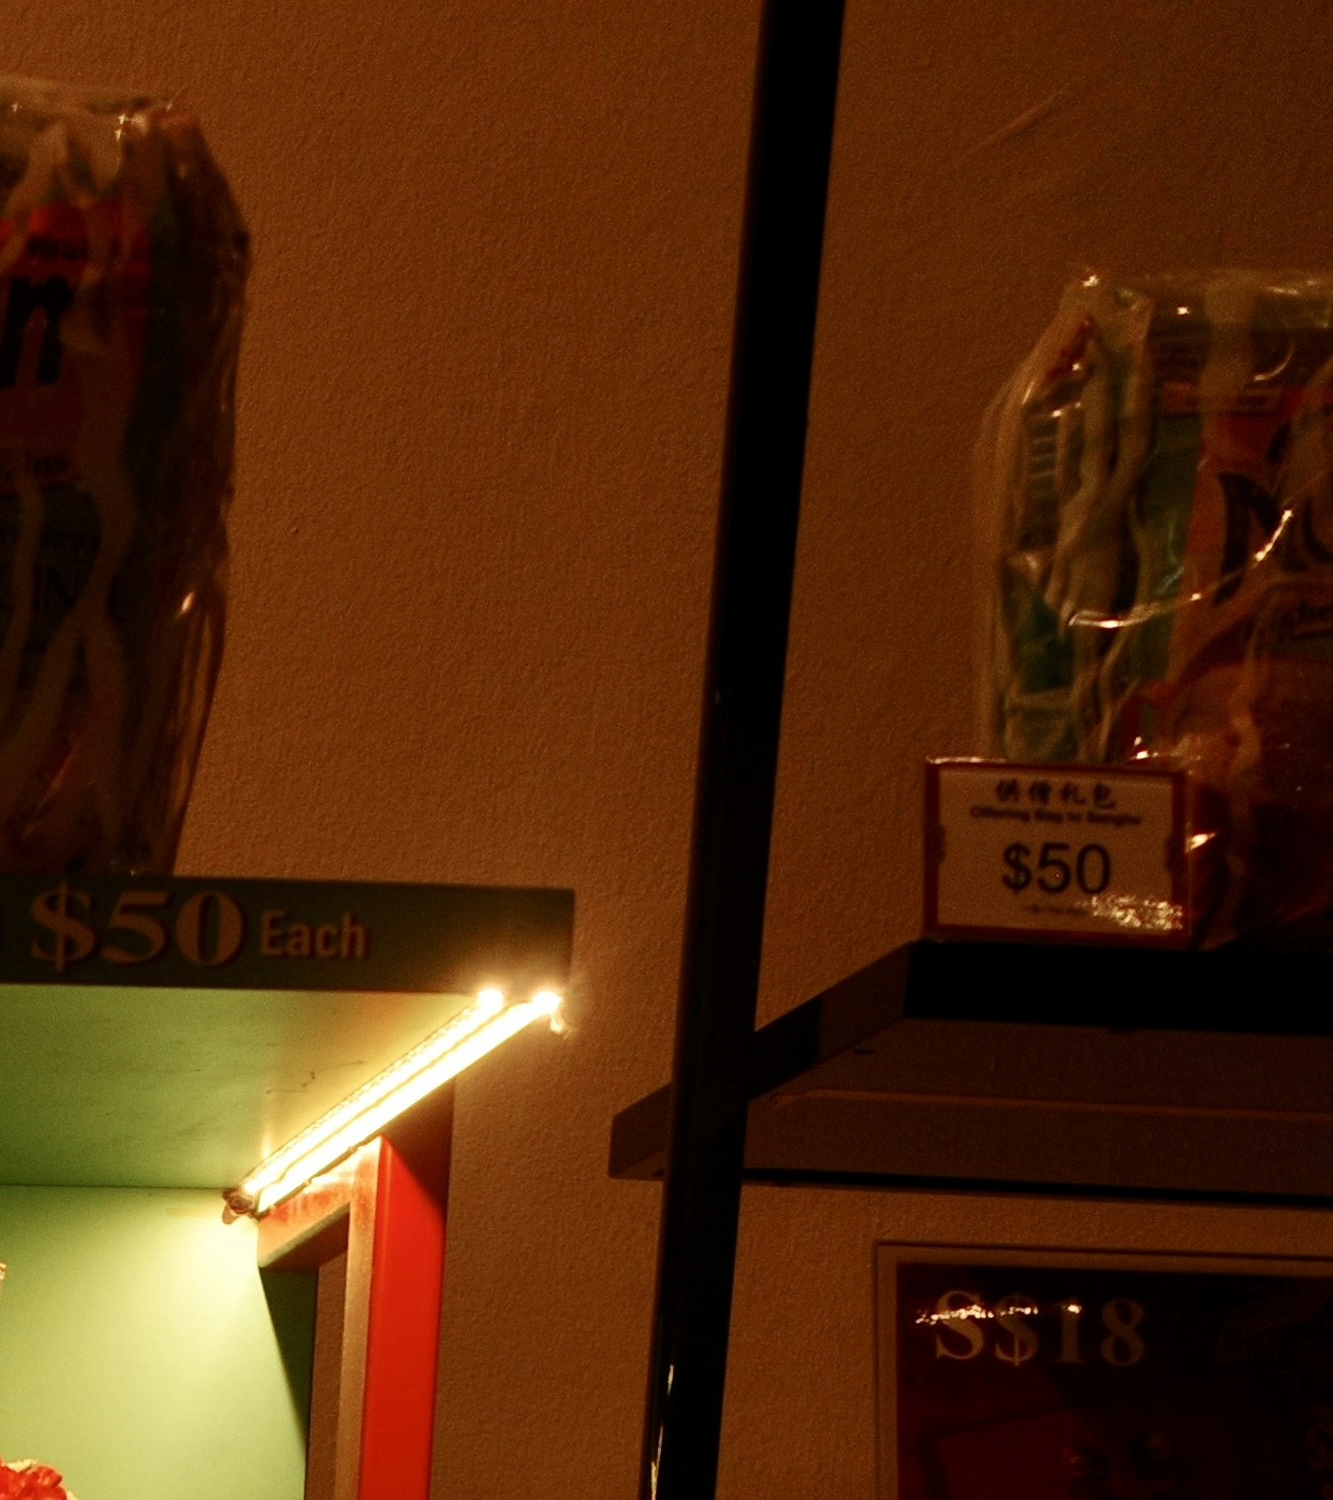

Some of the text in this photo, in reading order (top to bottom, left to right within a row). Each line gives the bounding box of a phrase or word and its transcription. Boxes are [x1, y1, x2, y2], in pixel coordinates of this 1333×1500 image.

[1001, 841, 1112, 895] $50
[30, 881, 245, 973] $50
[259, 912, 371, 962] Each
[935, 1288, 1148, 1369] S$18
